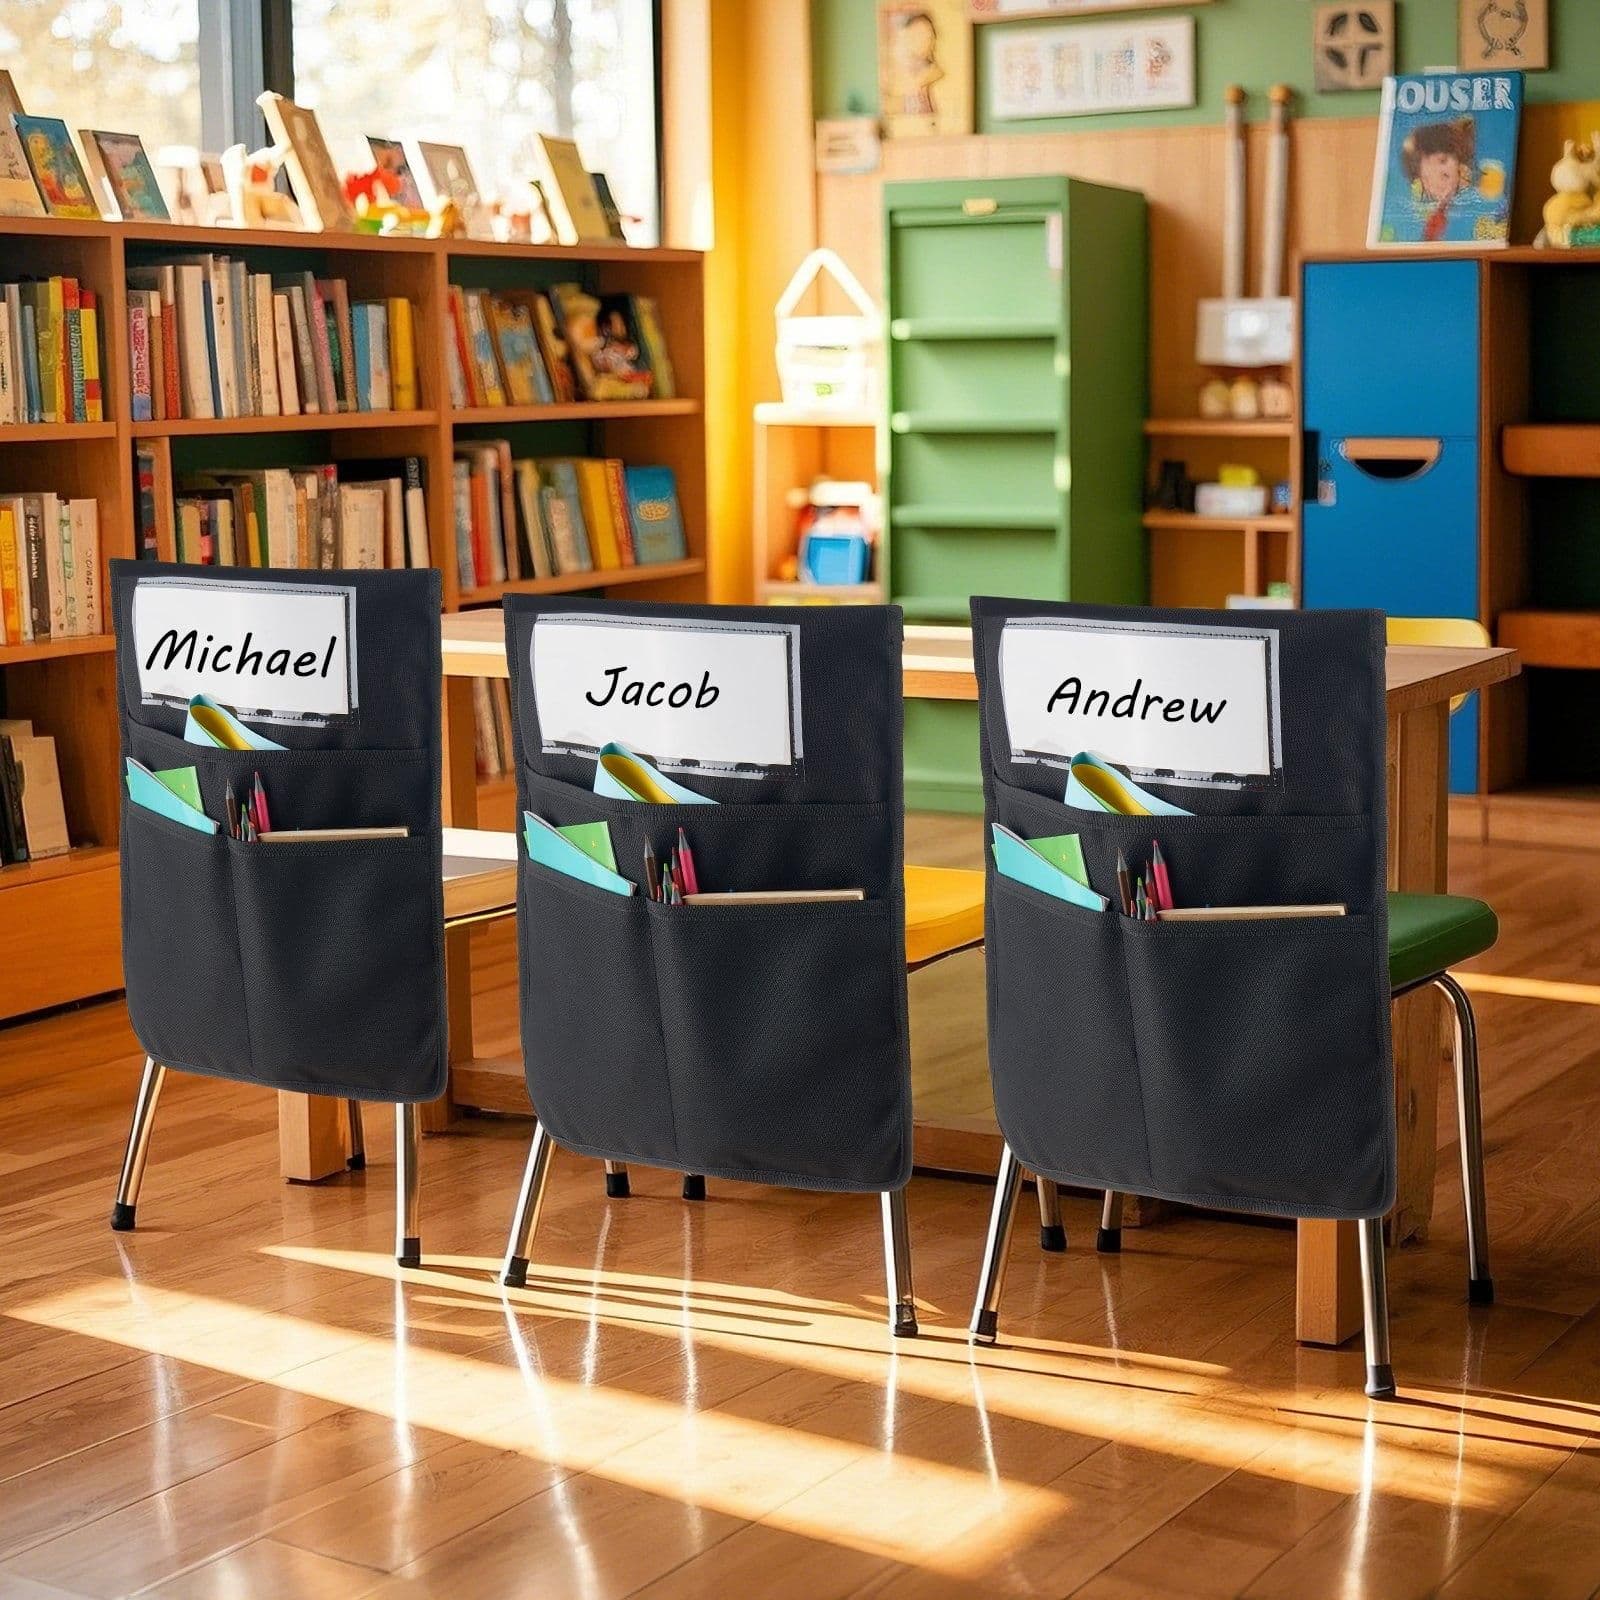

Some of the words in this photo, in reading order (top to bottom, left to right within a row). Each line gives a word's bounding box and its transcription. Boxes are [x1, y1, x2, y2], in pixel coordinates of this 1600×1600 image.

[145, 629, 337, 678] Michael
[585, 666, 720, 709] Jacob
[1047, 677, 1227, 724] Andrew
